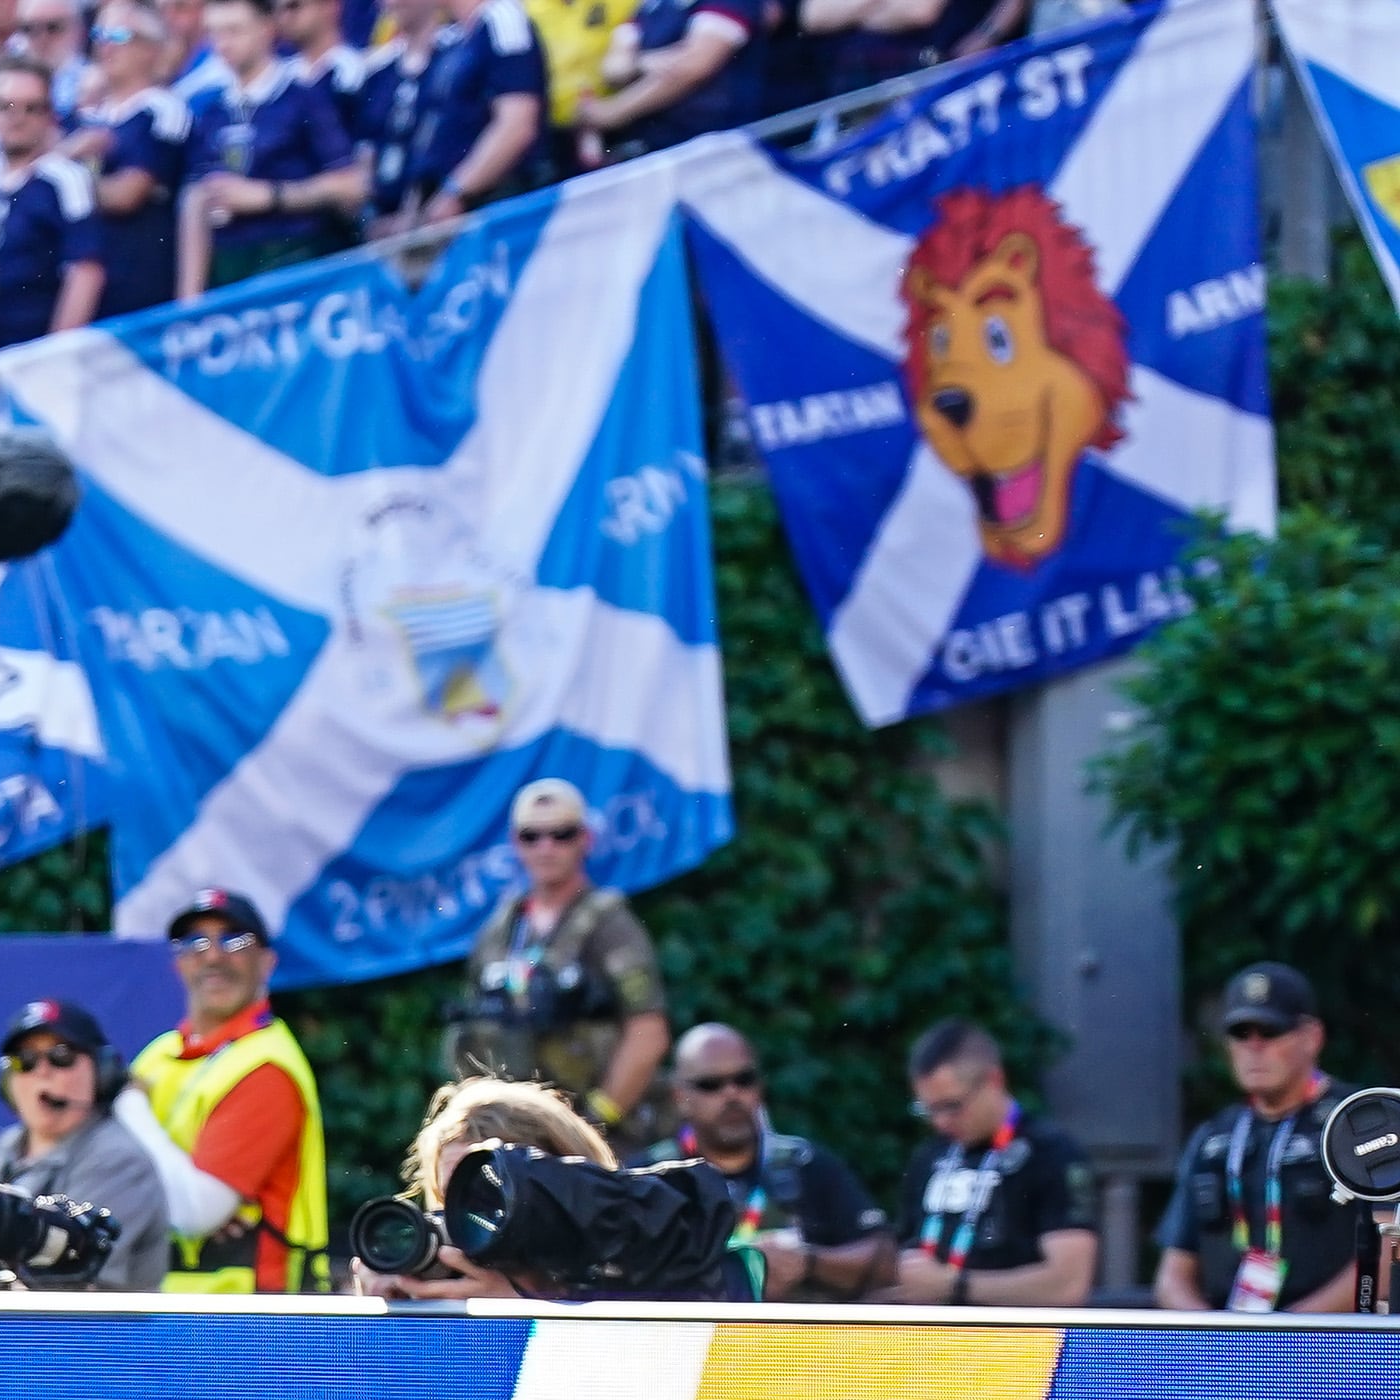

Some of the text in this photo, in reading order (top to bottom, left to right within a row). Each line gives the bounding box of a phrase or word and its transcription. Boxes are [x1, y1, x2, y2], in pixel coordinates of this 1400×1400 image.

[1016, 42, 1094, 120] ST
[161, 300, 305, 384] PORT
[1166, 264, 1267, 340] ARM
[943, 609, 1038, 683] GIE
[1040, 592, 1090, 655] IT
